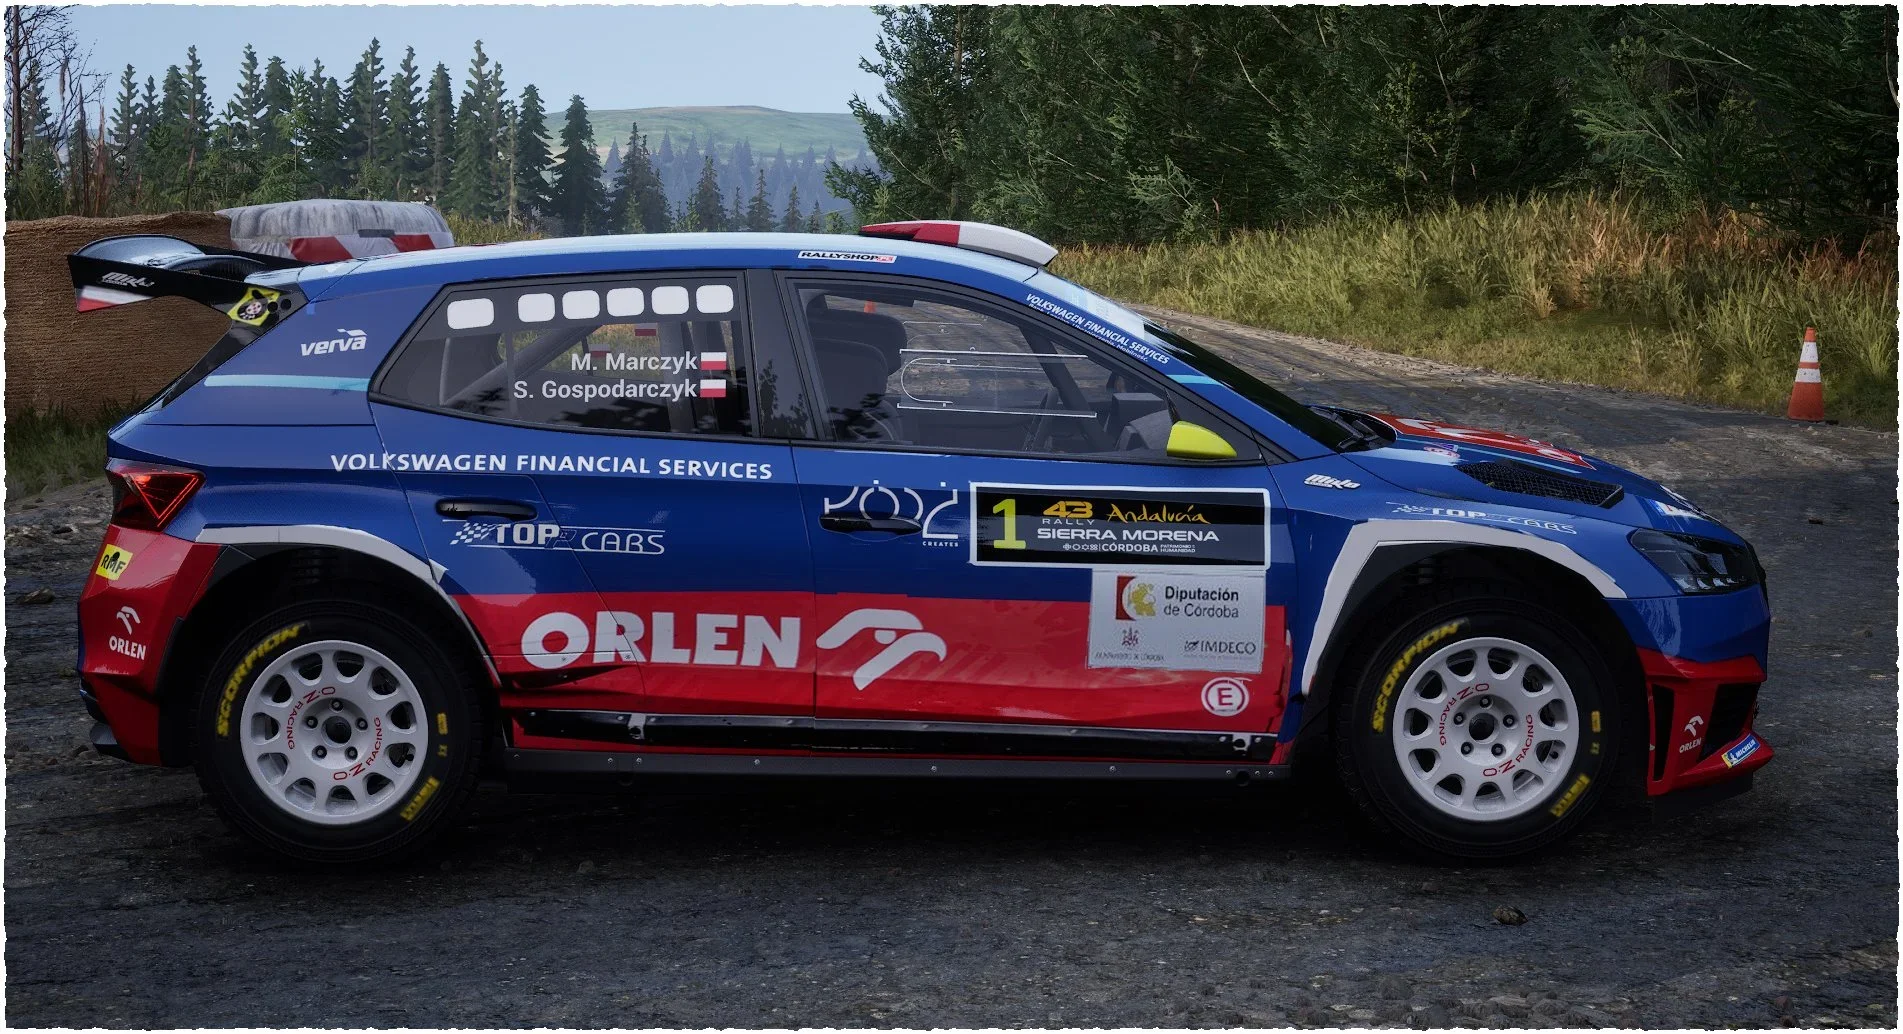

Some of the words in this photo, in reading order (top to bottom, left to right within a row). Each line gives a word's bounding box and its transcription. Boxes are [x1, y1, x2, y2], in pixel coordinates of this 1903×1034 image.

[801, 251, 879, 261] RALLYSHOP
[1026, 293, 1086, 325] VOLKSWAGEN
[1083, 320, 1130, 346] FINANCIAL
[1129, 341, 1170, 365] SERVICES
[300, 336, 367, 356] verva
[571, 353, 598, 371] M.
[605, 351, 698, 375] Marczyk
[513, 380, 534, 398] S.
[541, 379, 698, 402] Gospodarczyk
[330, 454, 507, 471] VOLKSWAGEN
[516, 455, 651, 474] FINANCIAL
[658, 459, 773, 480] SERVICES
[992, 498, 1027, 550] 1
[1042, 518, 1096, 526] RALLY
[1043, 500, 1094, 519] 43
[1106, 503, 1212, 525] Andalucía
[1431, 507, 1487, 519] TOP
[1507, 516, 1578, 535] CARS
[497, 523, 560, 545] TOP
[581, 531, 666, 555] CARS
[1037, 528, 1118, 541] SIERRA
[1122, 529, 1220, 542] MORENA
[1101, 541, 1159, 553] CÓRDOBA
[100, 552, 127, 574] RMF
[1164, 585, 1240, 603] Diputación
[1163, 604, 1180, 617] de
[1184, 603, 1240, 618] Córdoba
[108, 635, 147, 661] ORLEN
[520, 610, 802, 670] ORLEN
[1200, 640, 1257, 655] IMDECO
[1217, 687, 1234, 706] E
[286, 700, 304, 750] RACING
[1439, 696, 1457, 746] RACING
[365, 716, 383, 767] RACING
[1515, 714, 1534, 763] RACING
[1679, 737, 1702, 754] ORLEN
